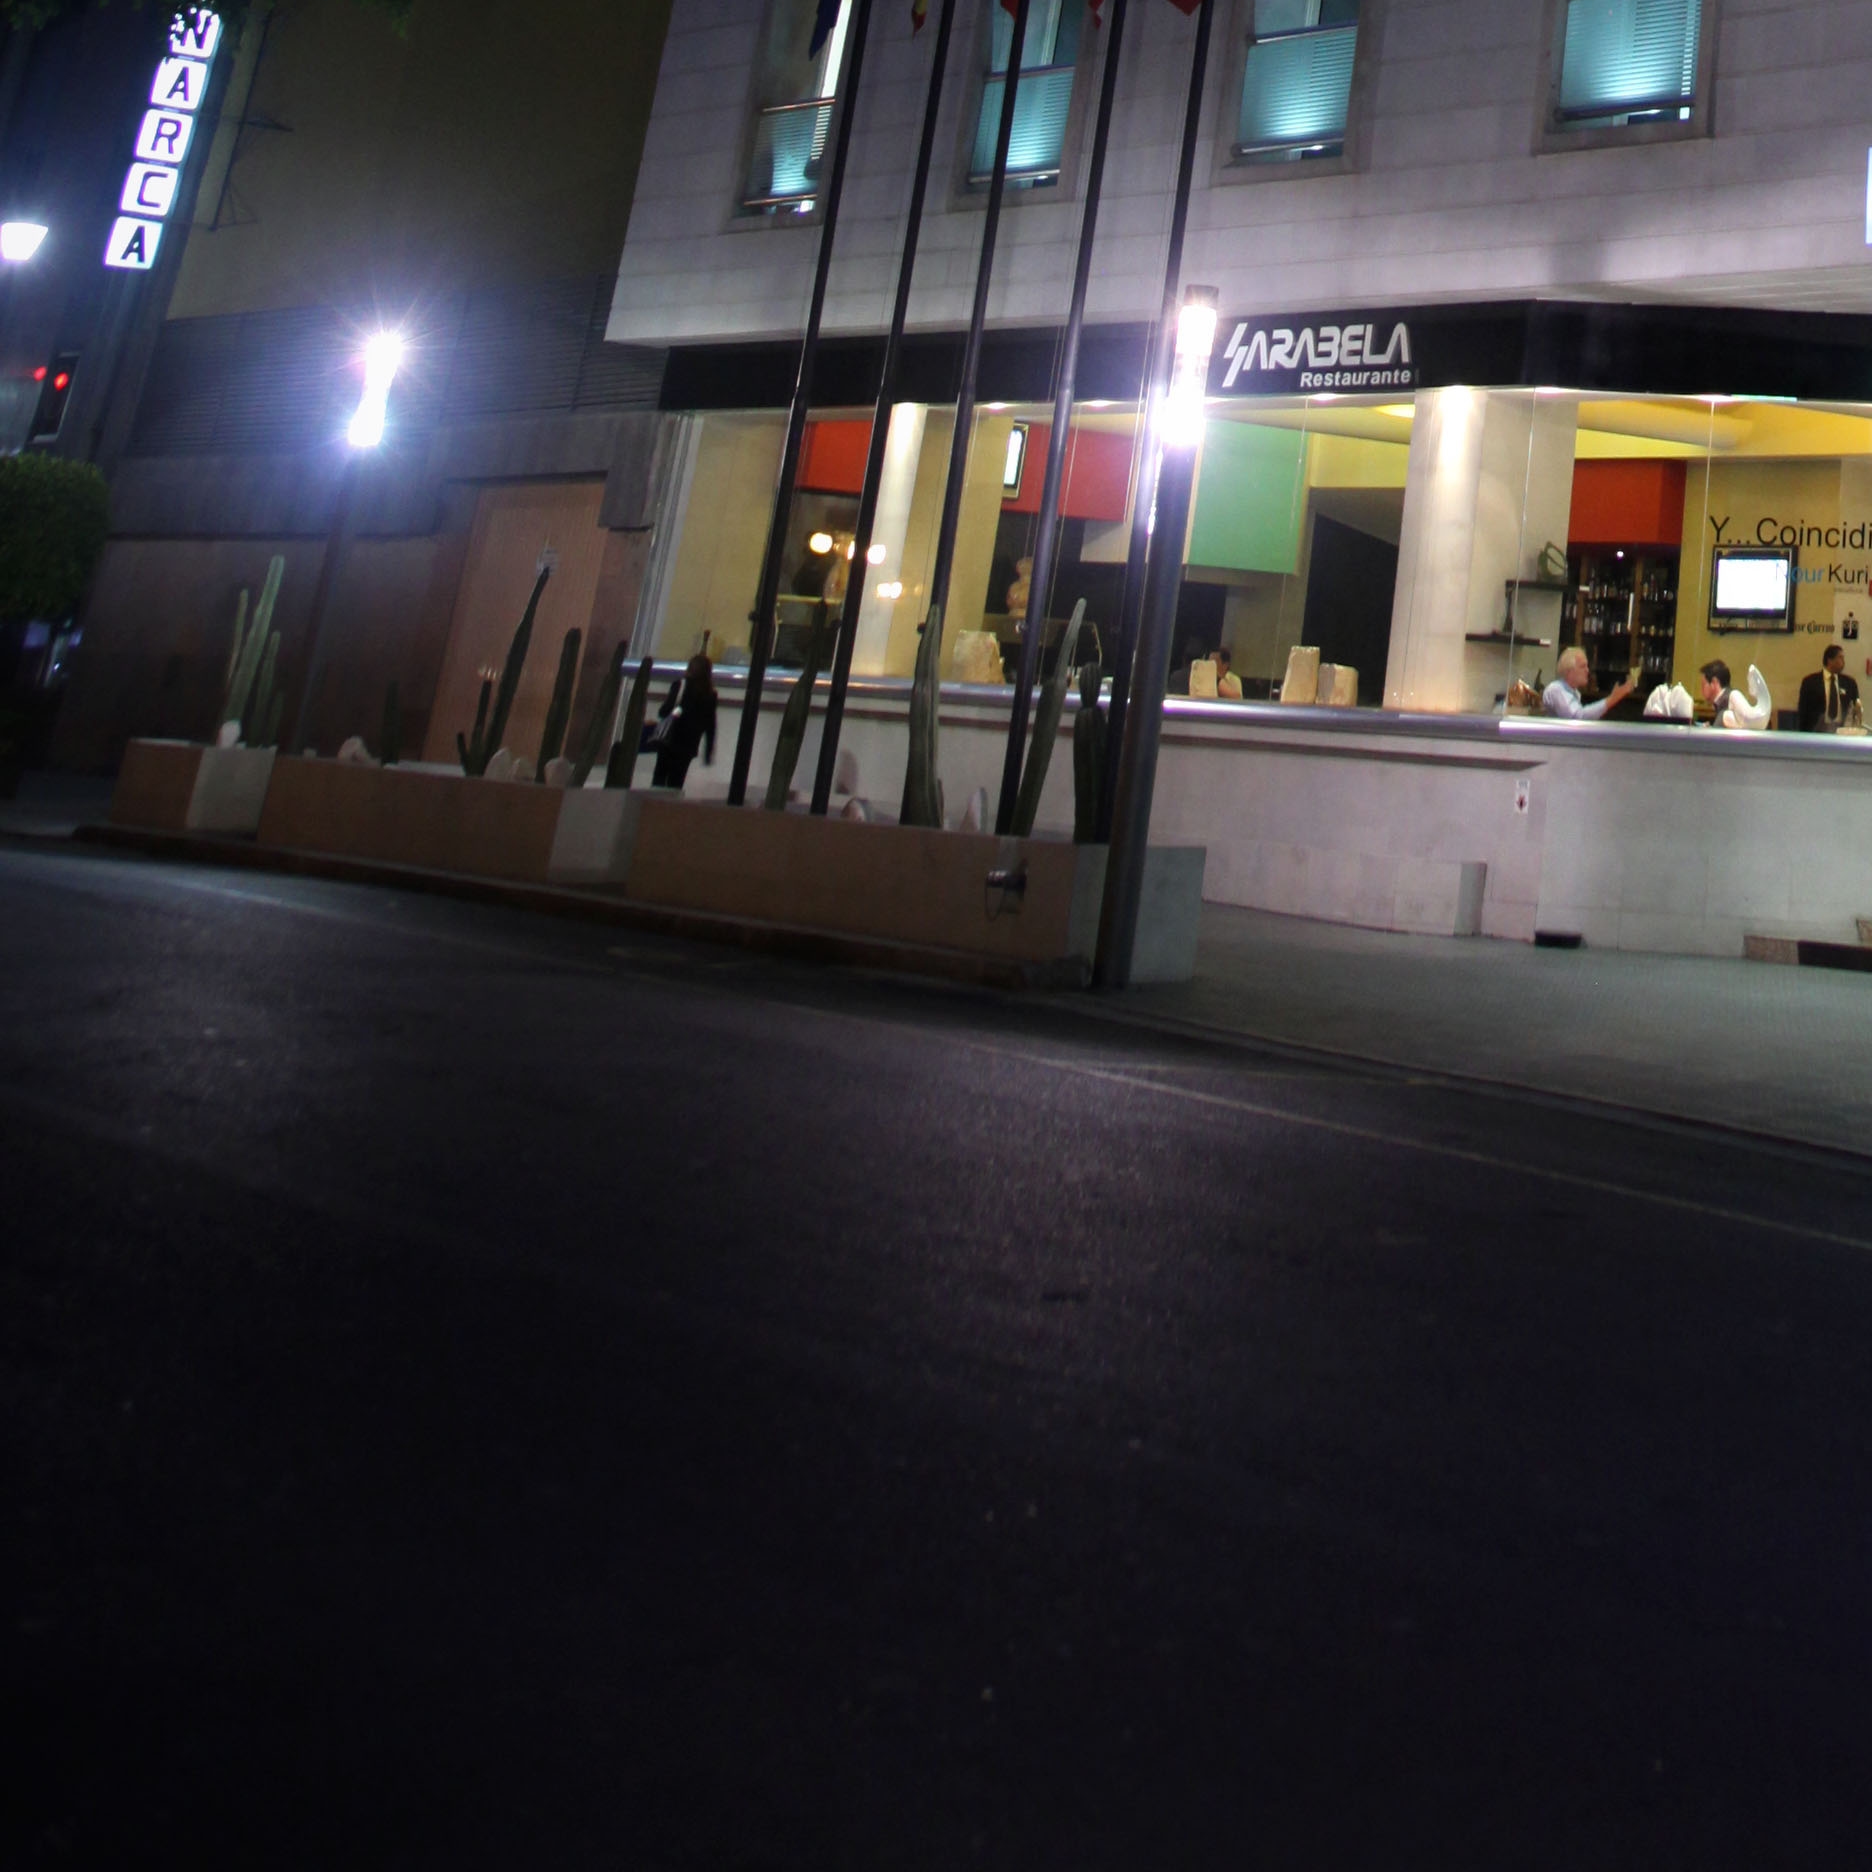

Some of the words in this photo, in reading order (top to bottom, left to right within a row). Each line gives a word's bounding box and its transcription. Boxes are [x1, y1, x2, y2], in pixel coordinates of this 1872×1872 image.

[1222, 322, 1410, 388] SARABELA
[1300, 369, 1412, 388] Restaurante
[1828, 563, 1869, 584] Kuri
